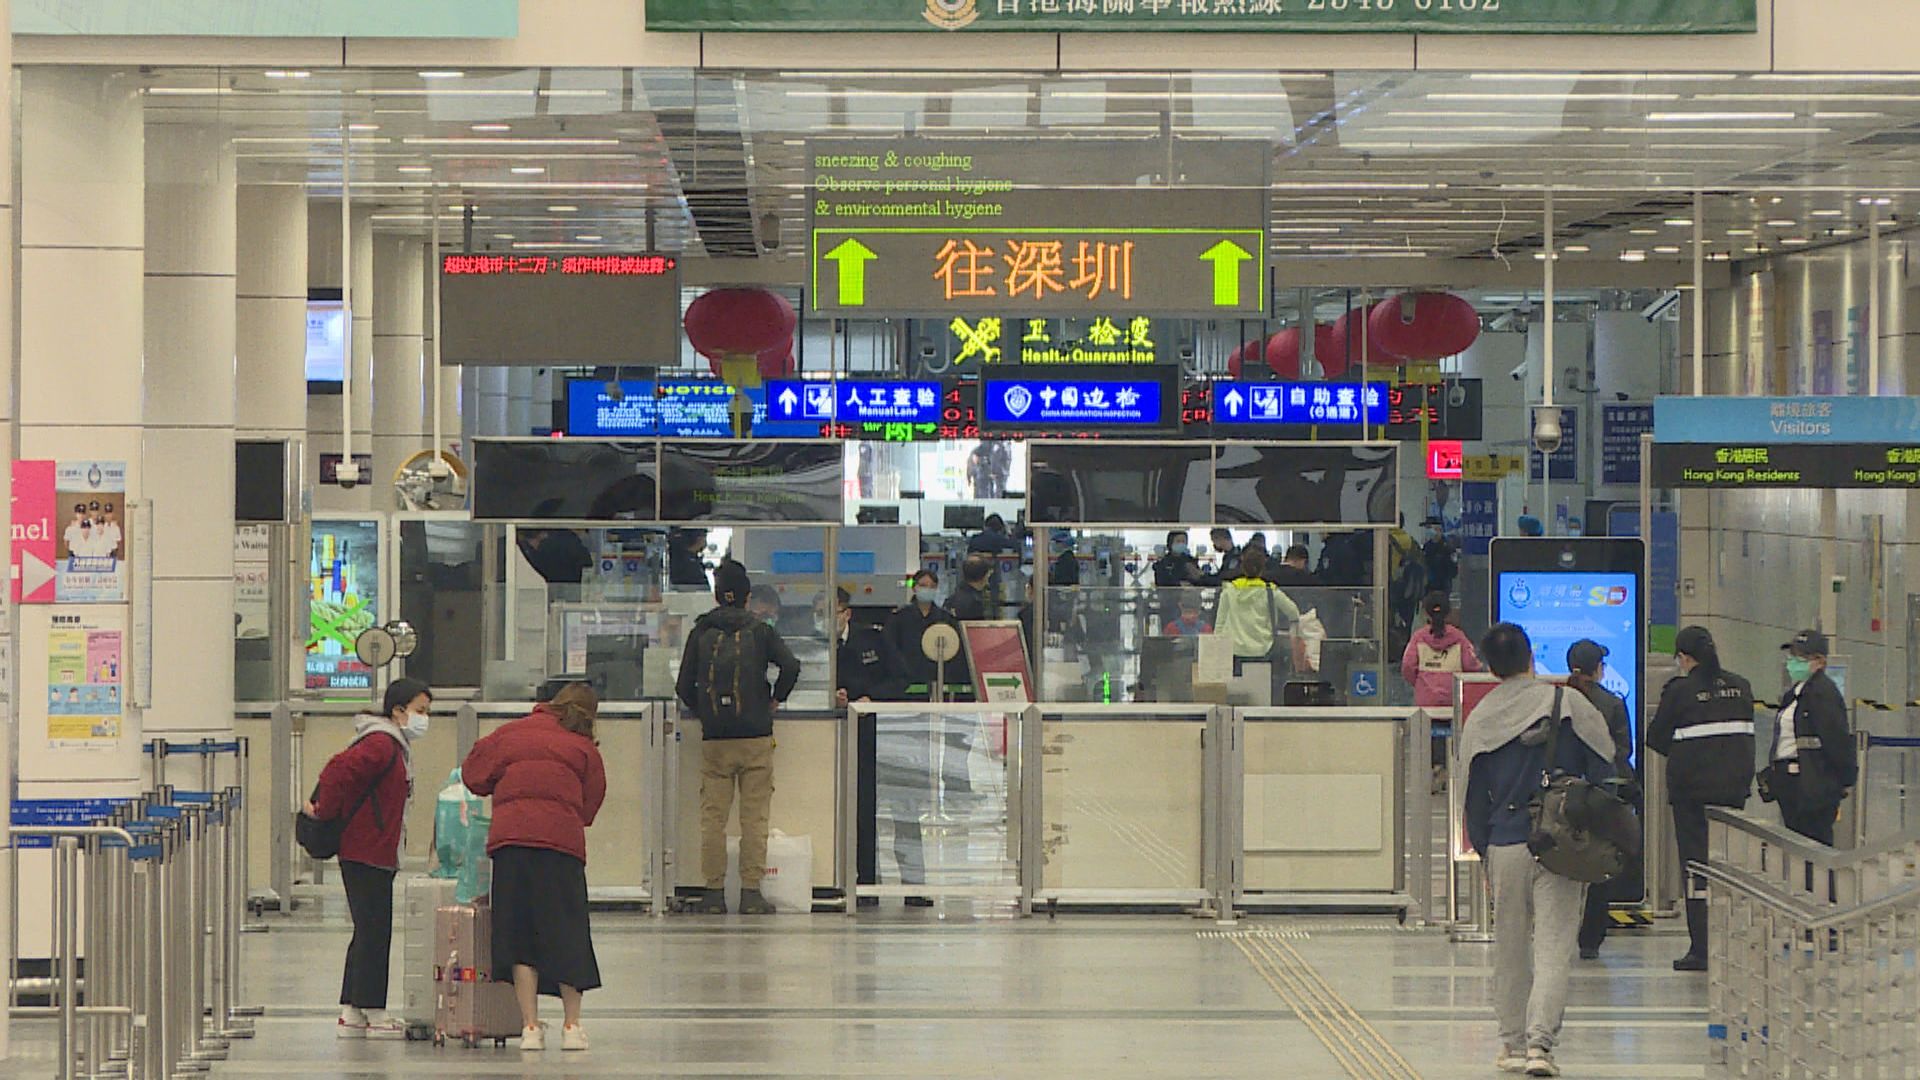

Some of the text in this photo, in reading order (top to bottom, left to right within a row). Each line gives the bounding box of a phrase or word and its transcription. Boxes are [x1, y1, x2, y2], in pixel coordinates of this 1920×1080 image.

[815, 150, 972, 171] sneezing & coughing
[815, 174, 1013, 195] Observe personal hygiene
[815, 200, 1003, 219] & environmental hygiene
[933, 239, 1134, 300] 往深圳
[846, 387, 936, 407] 人工查验
[1039, 384, 1141, 408] 中国边检
[1769, 419, 1832, 435] Visitors
[1715, 447, 1769, 464] 香港居民
[1684, 467, 1800, 482] Hong Kong Residents
[1855, 469, 1916, 483] Hong Kong
